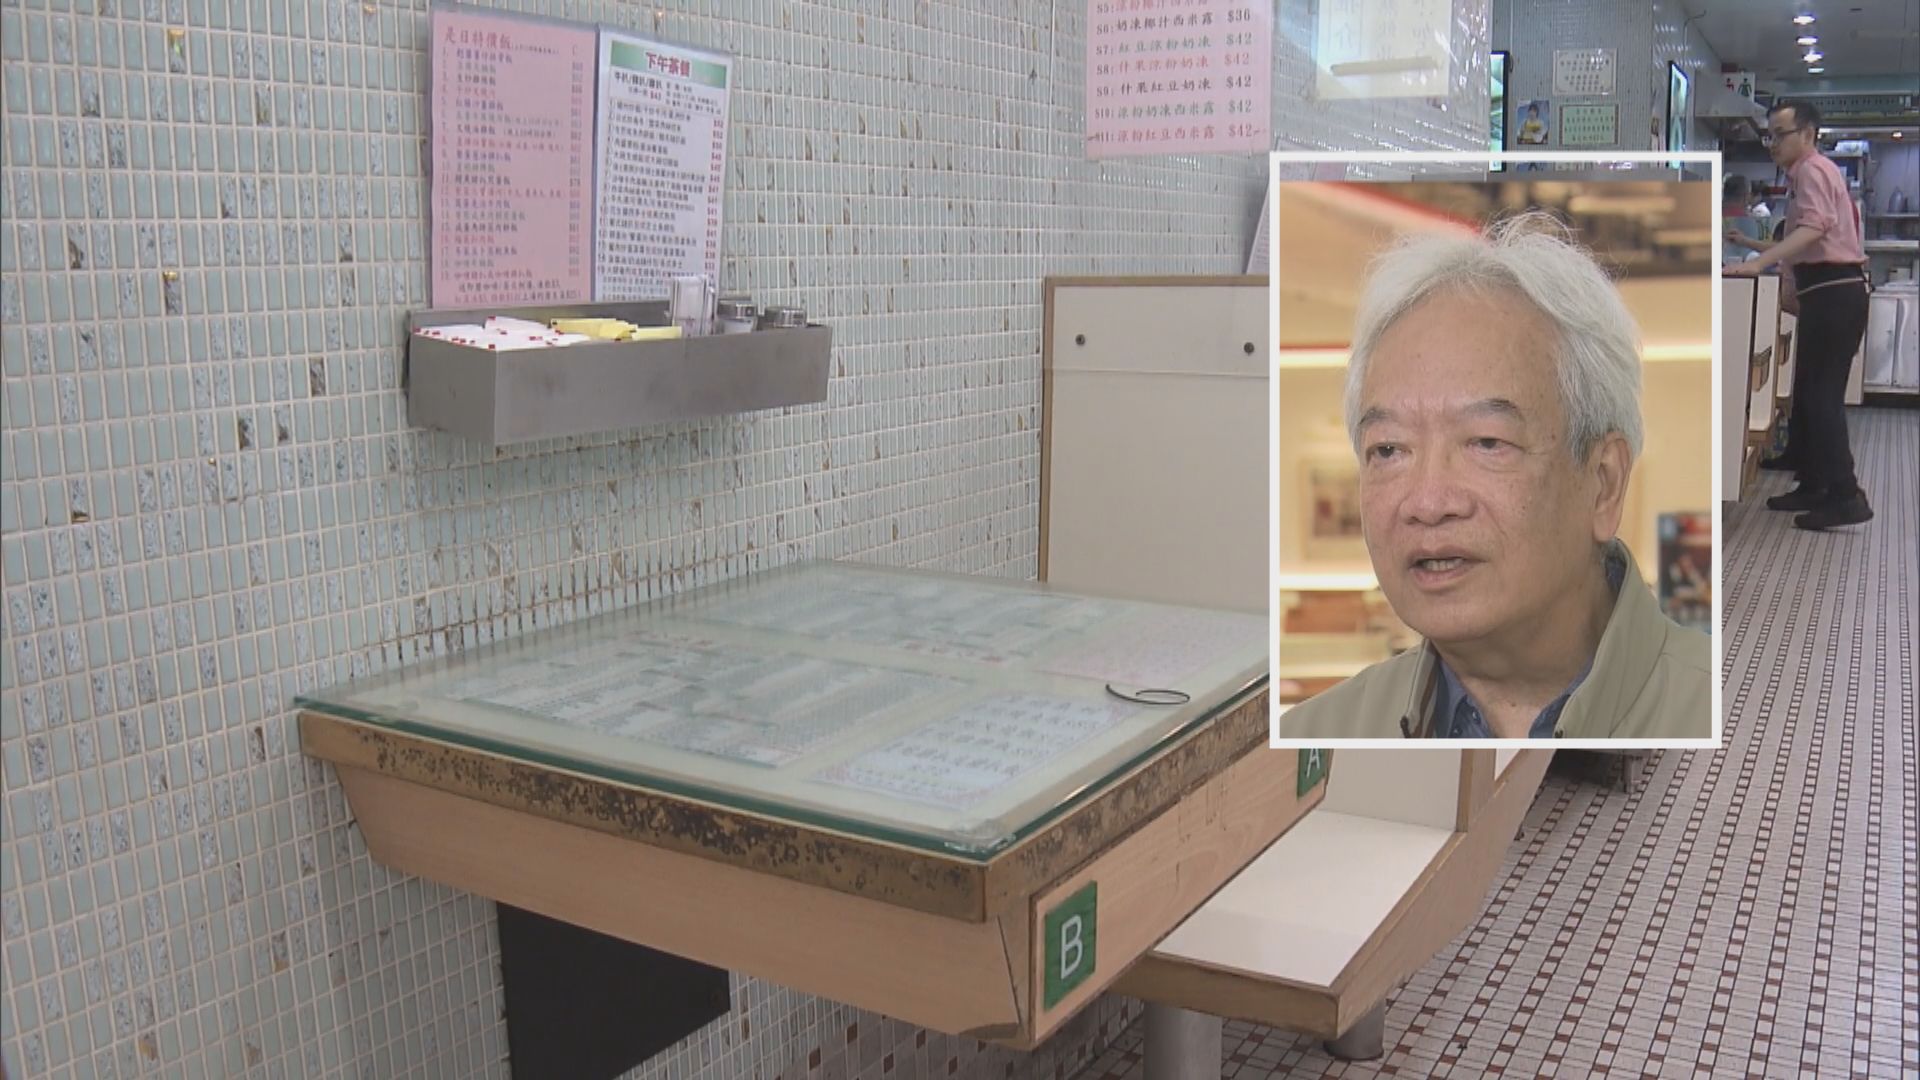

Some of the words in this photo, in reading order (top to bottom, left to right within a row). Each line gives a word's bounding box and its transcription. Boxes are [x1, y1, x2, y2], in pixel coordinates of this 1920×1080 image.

[1226, 32, 1252, 46] $42
[645, 50, 690, 78] 下午茶餐
[1224, 53, 1250, 66] $42
[1226, 75, 1252, 89] $42
[1228, 99, 1252, 113] $42
[1306, 748, 1320, 778] A
[1060, 914, 1083, 980] B
